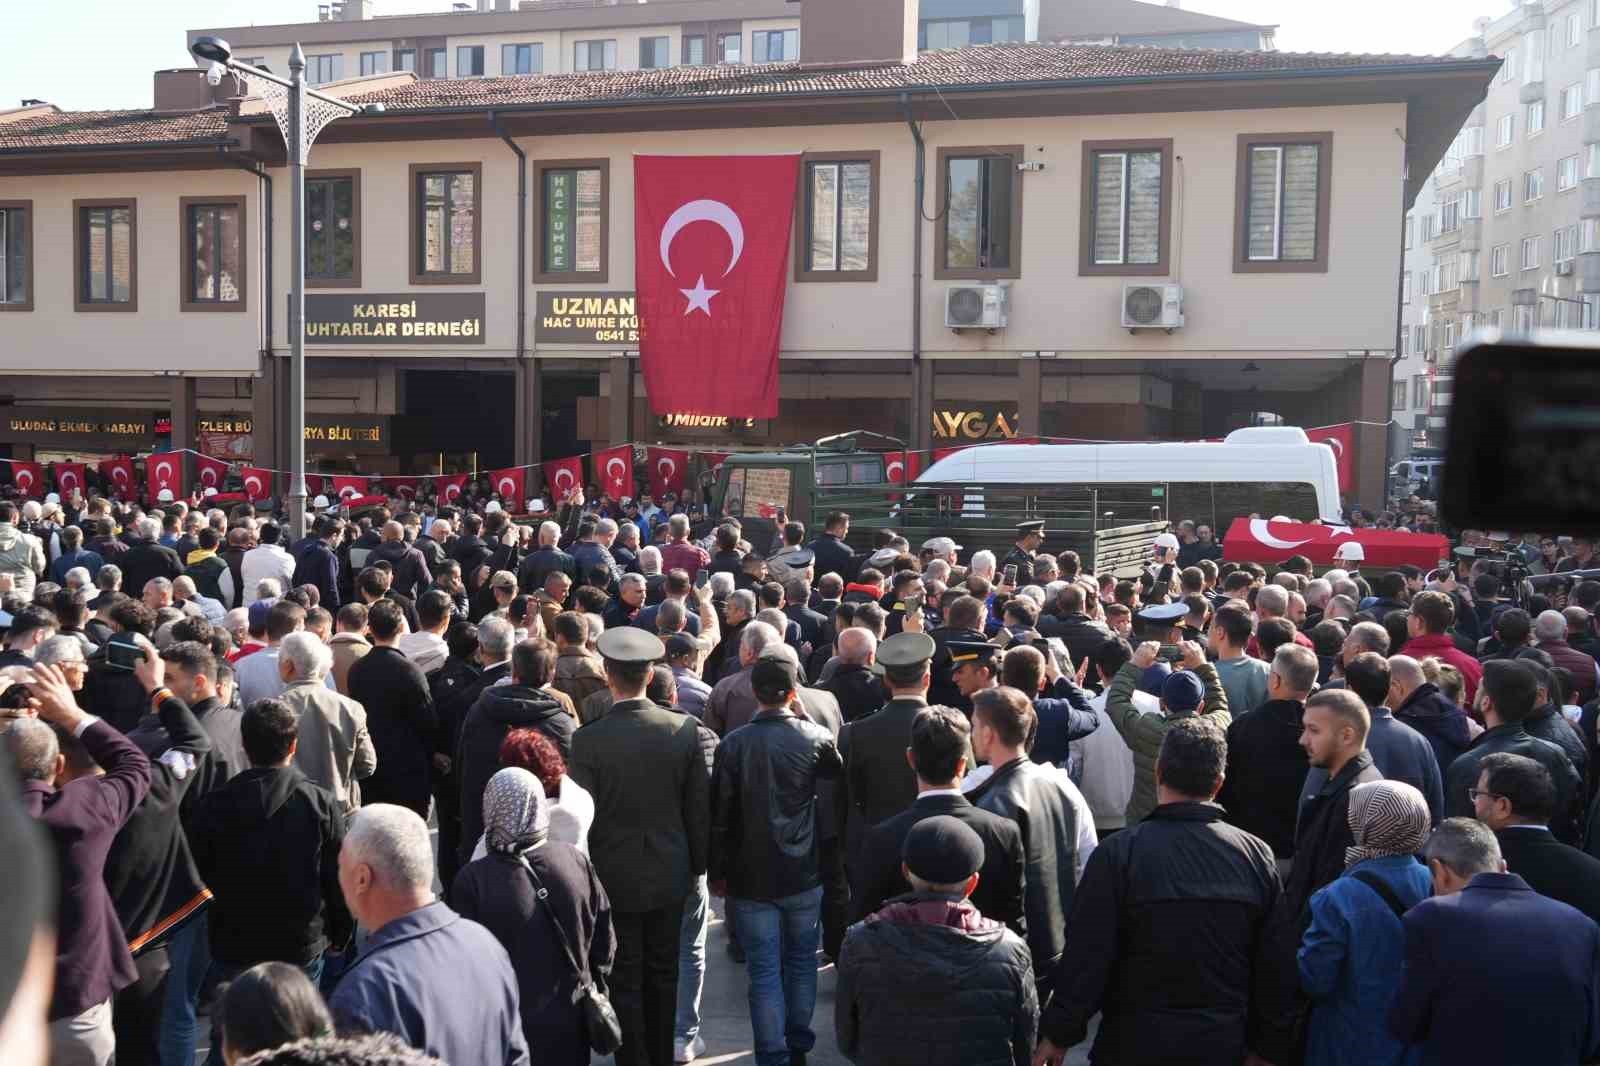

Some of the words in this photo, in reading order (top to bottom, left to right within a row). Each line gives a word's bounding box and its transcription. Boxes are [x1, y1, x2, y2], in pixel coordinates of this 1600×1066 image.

[353, 301, 417, 318] KARESİ
[552, 298, 635, 315] UZMAN
[306, 322, 398, 337] UHTARLAR
[401, 319, 480, 337] DERNEĞİ
[543, 317, 571, 328] HAC
[576, 317, 616, 328] UMRE
[595, 331, 625, 341] 0541
[200, 421, 232, 432] ZLER
